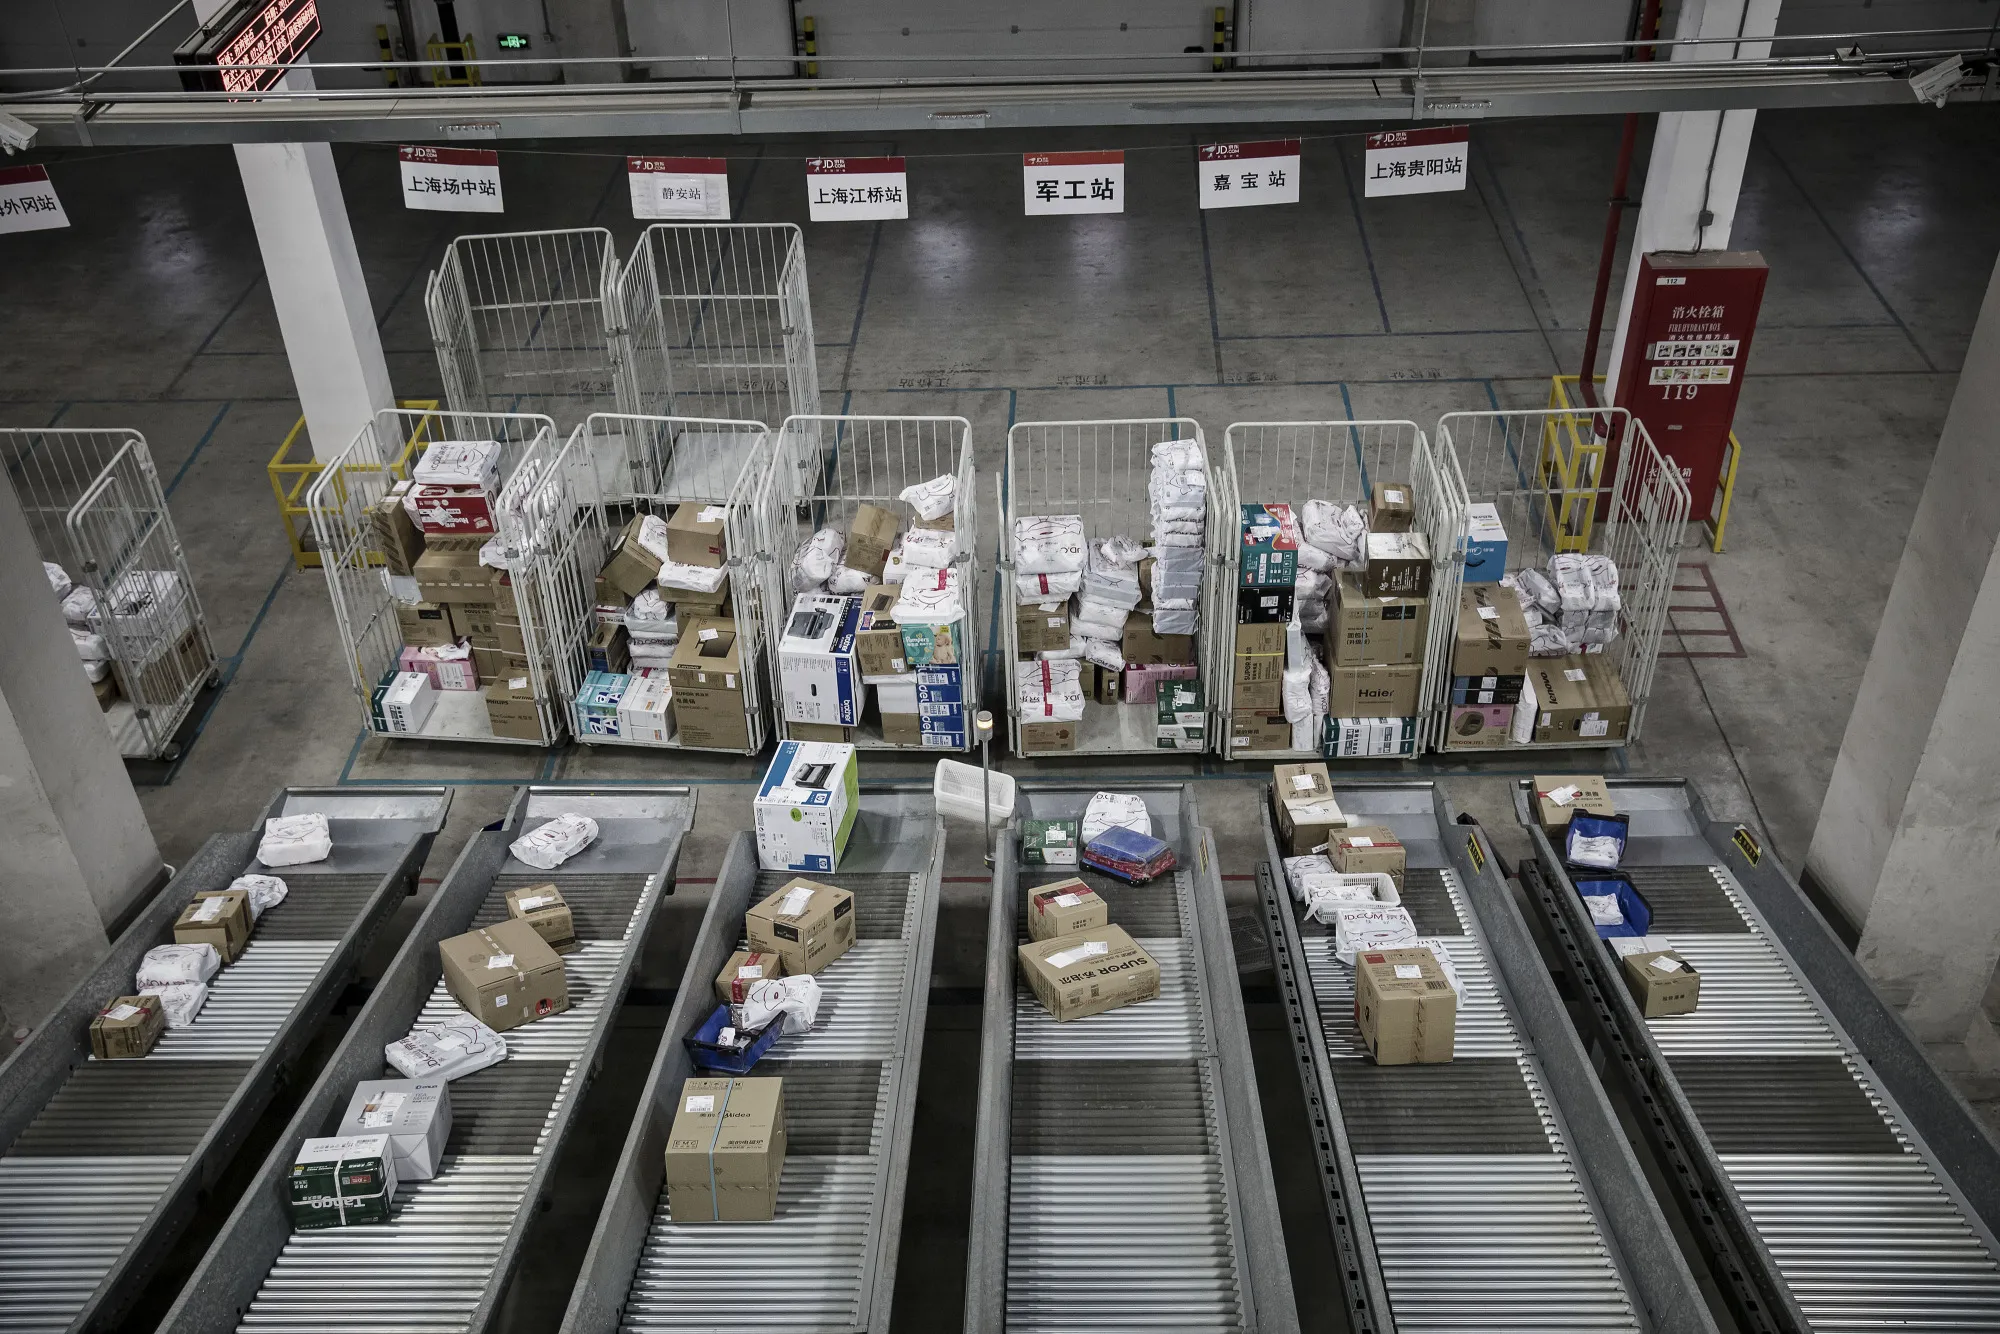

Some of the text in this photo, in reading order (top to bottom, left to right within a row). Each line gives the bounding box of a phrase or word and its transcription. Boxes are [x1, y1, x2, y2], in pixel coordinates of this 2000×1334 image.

[1370, 157, 1462, 180] 上海贵阳站
[408, 176, 496, 195] 上海场中站
[1214, 170, 1286, 191] 嘉宝站
[661, 187, 701, 200] 静安站
[814, 186, 902, 204] 上海江桥站
[1036, 178, 1115, 202] 军工站
[0, 194, 56, 216] 外冈站
[1672, 306, 1724, 318] 消火栓箱
[1668, 323, 1722, 332] FIRE HYDRANT BOX
[1662, 385, 1698, 400] 119
[842, 634, 853, 652] brother
[1359, 689, 1394, 697] Haier
[1541, 672, 1558, 704] lenovo
[1101, 957, 1148, 976] SUPOR
[1059, 970, 1100, 984] 苏泊尔
[311, 1196, 366, 1210] Tango
